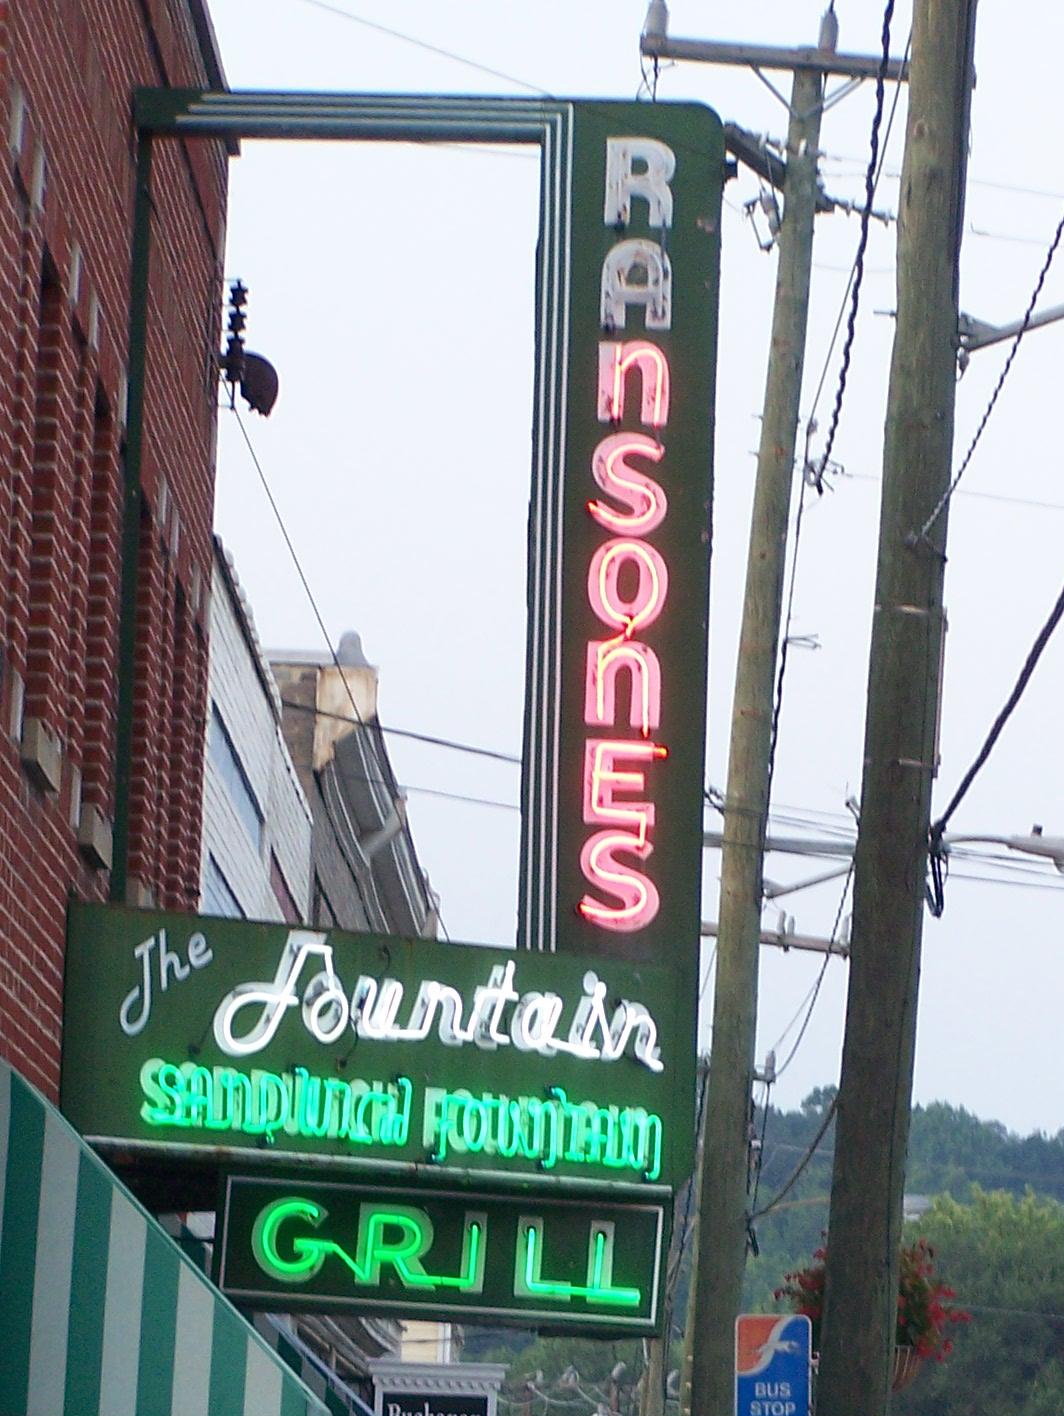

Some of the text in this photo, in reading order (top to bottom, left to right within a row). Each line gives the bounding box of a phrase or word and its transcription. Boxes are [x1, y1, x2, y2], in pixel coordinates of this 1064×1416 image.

[120, 929, 665, 1073] The Fountain
[422, 1085, 664, 1182] FOUNTAIN
[252, 1197, 642, 1306] GRILL
[754, 1382, 791, 1399] BUS
